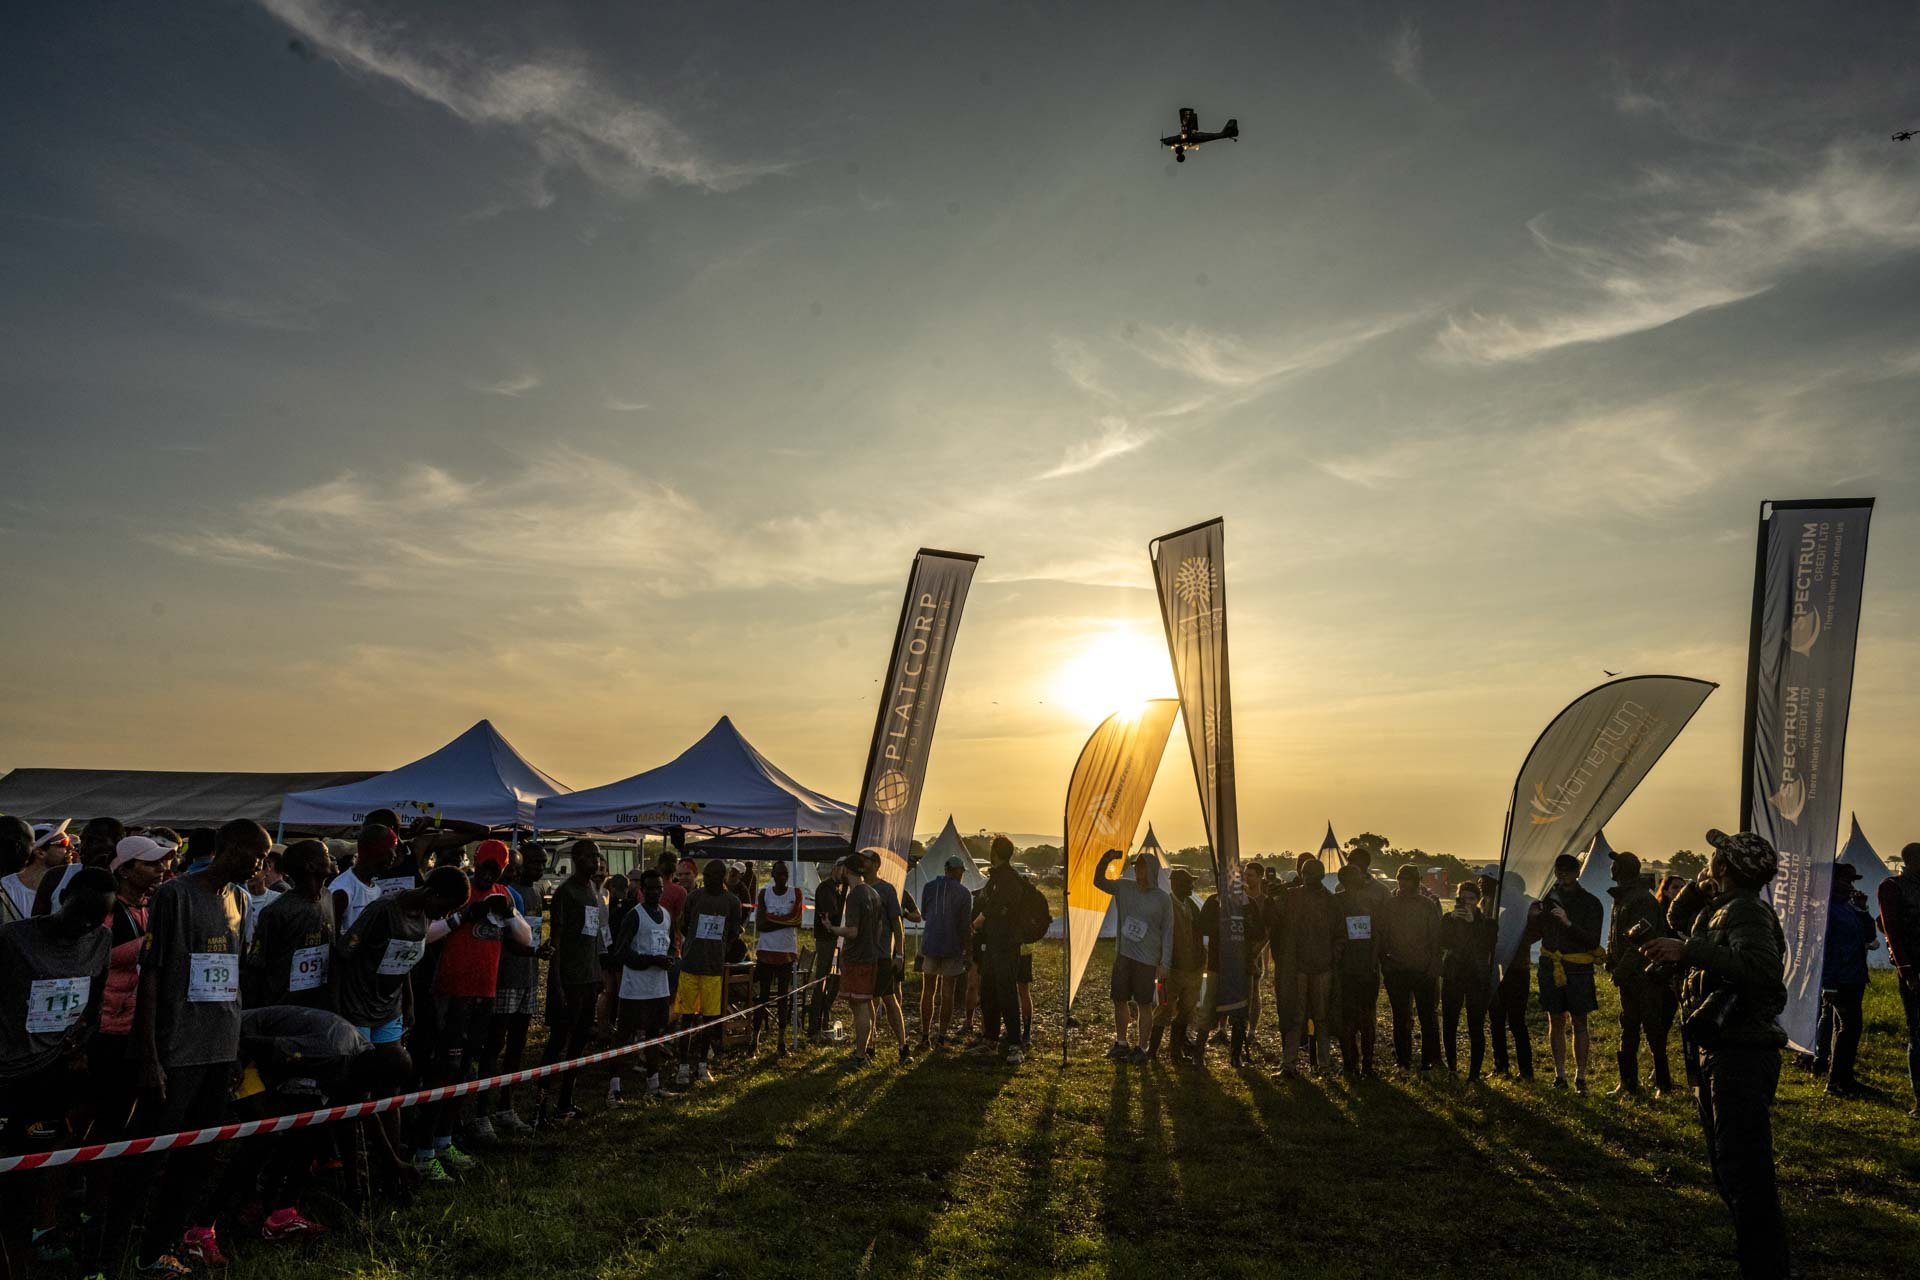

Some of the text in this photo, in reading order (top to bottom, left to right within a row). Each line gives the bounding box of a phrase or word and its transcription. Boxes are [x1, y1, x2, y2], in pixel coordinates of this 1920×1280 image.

[1815, 522, 1830, 581] CREDIT LTD
[1824, 521, 1845, 631] There when you need us
[885, 593, 937, 761] PLATCORP
[906, 601, 951, 762] FOUNDATION
[1611, 712, 1659, 763] Credit
[1780, 686, 1800, 797] SPECTRUM
[1799, 687, 1811, 748] CREDIT LTD
[1808, 688, 1826, 800] There when you need us
[1545, 700, 1644, 812] Momentum
[616, 813, 691, 823] UltraMARAthon
[1773, 851, 1791, 929] CTRUM
[1788, 853, 1800, 915] CREDIT LTD
[1801, 895, 1809, 912] you
[1793, 942, 1802, 968] There
[1798, 915, 1806, 941] when
[45, 994, 80, 1011] 115
[203, 968, 230, 983] 139
